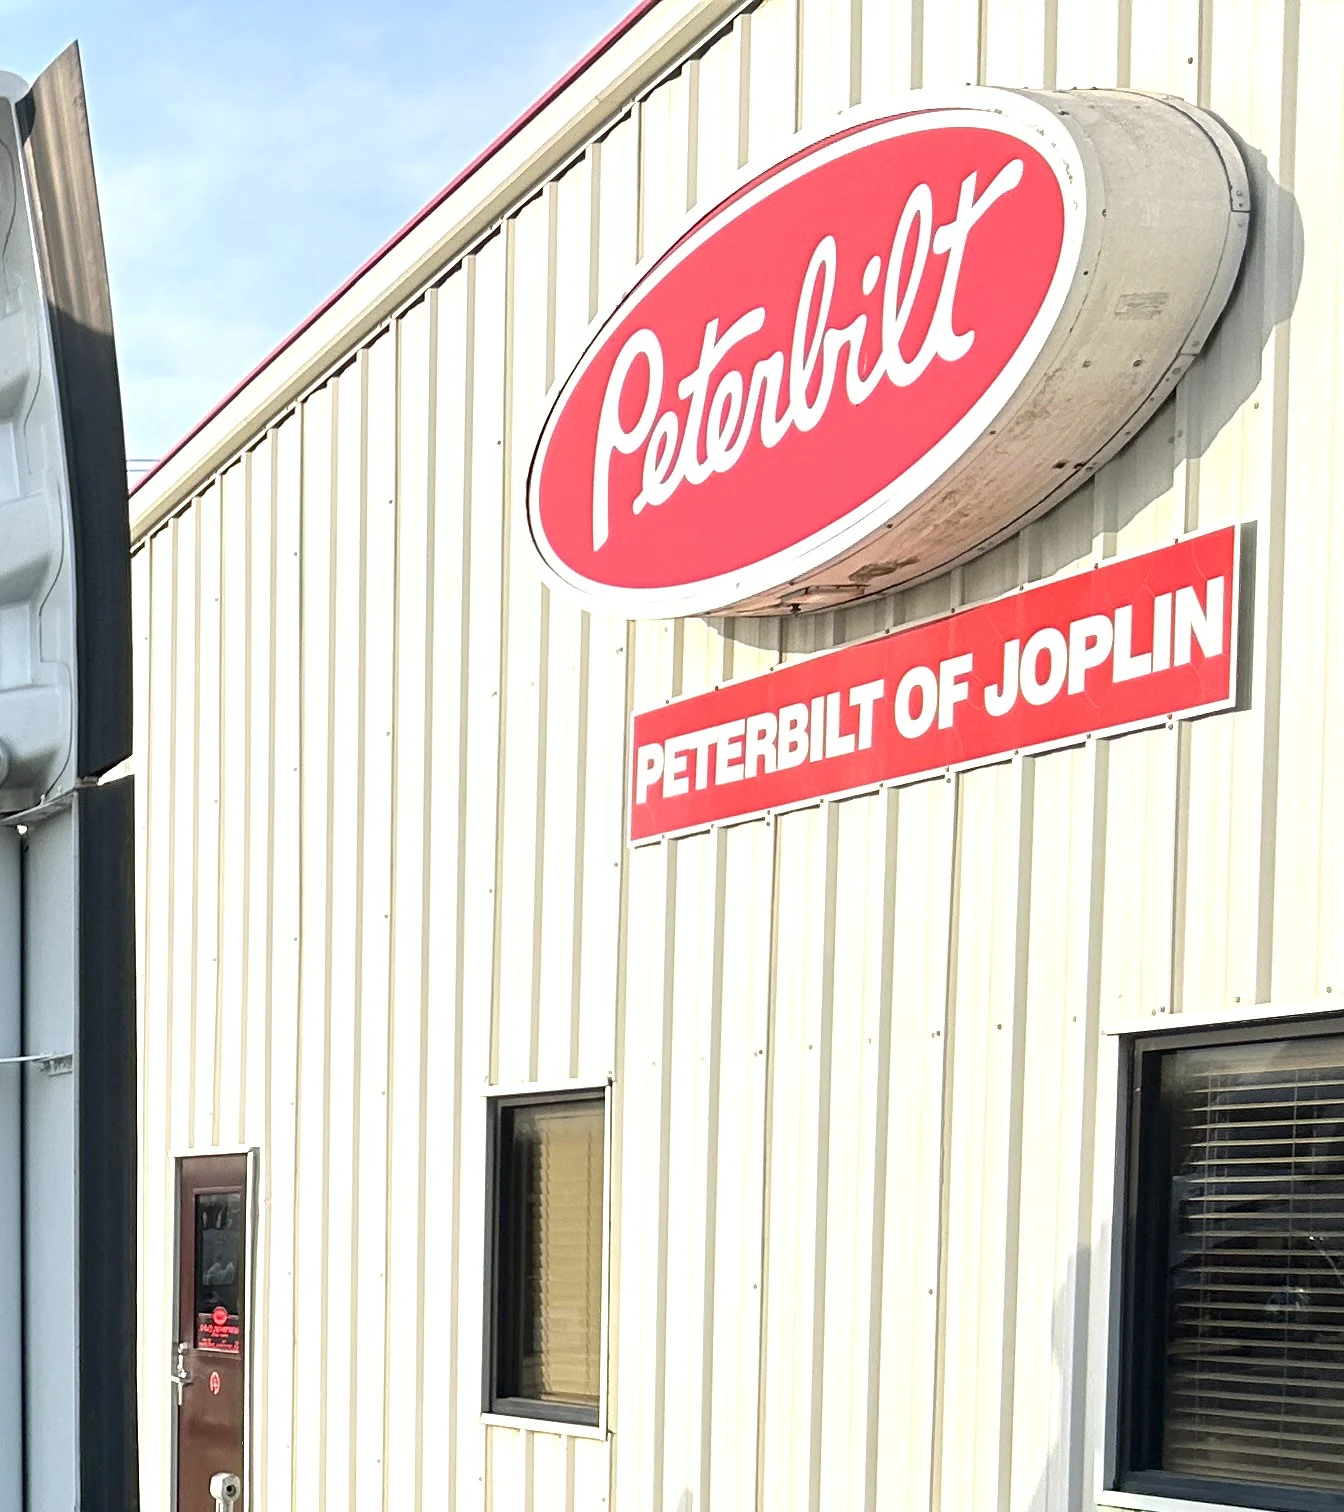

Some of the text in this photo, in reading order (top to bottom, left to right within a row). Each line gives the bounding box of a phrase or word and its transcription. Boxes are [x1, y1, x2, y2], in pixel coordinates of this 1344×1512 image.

[592, 157, 1024, 552] Peterbilt
[635, 576, 1226, 806] PETERBILT OF JOPLIN
